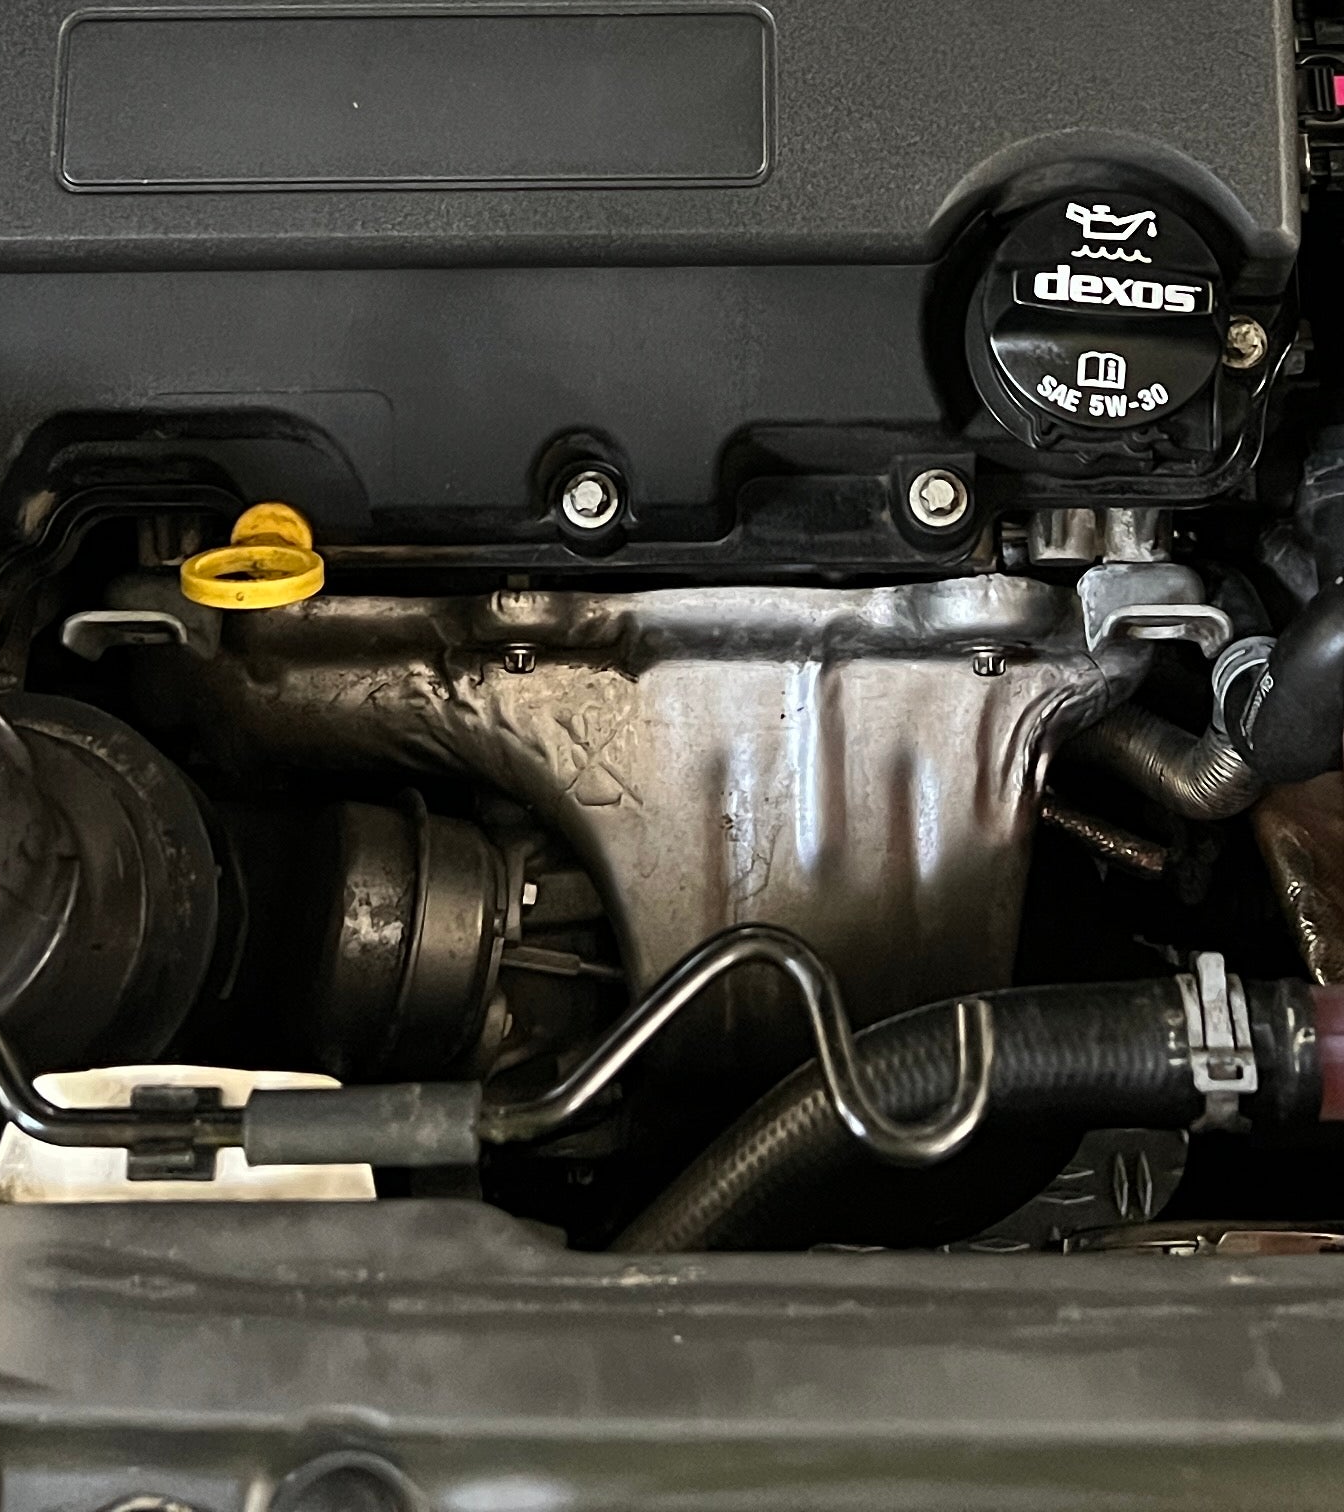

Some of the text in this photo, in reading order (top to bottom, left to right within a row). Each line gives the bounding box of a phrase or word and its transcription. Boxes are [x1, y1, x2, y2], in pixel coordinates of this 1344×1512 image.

[1033, 264, 1196, 313] dexos
[1036, 374, 1169, 419] SAE 5W-30
